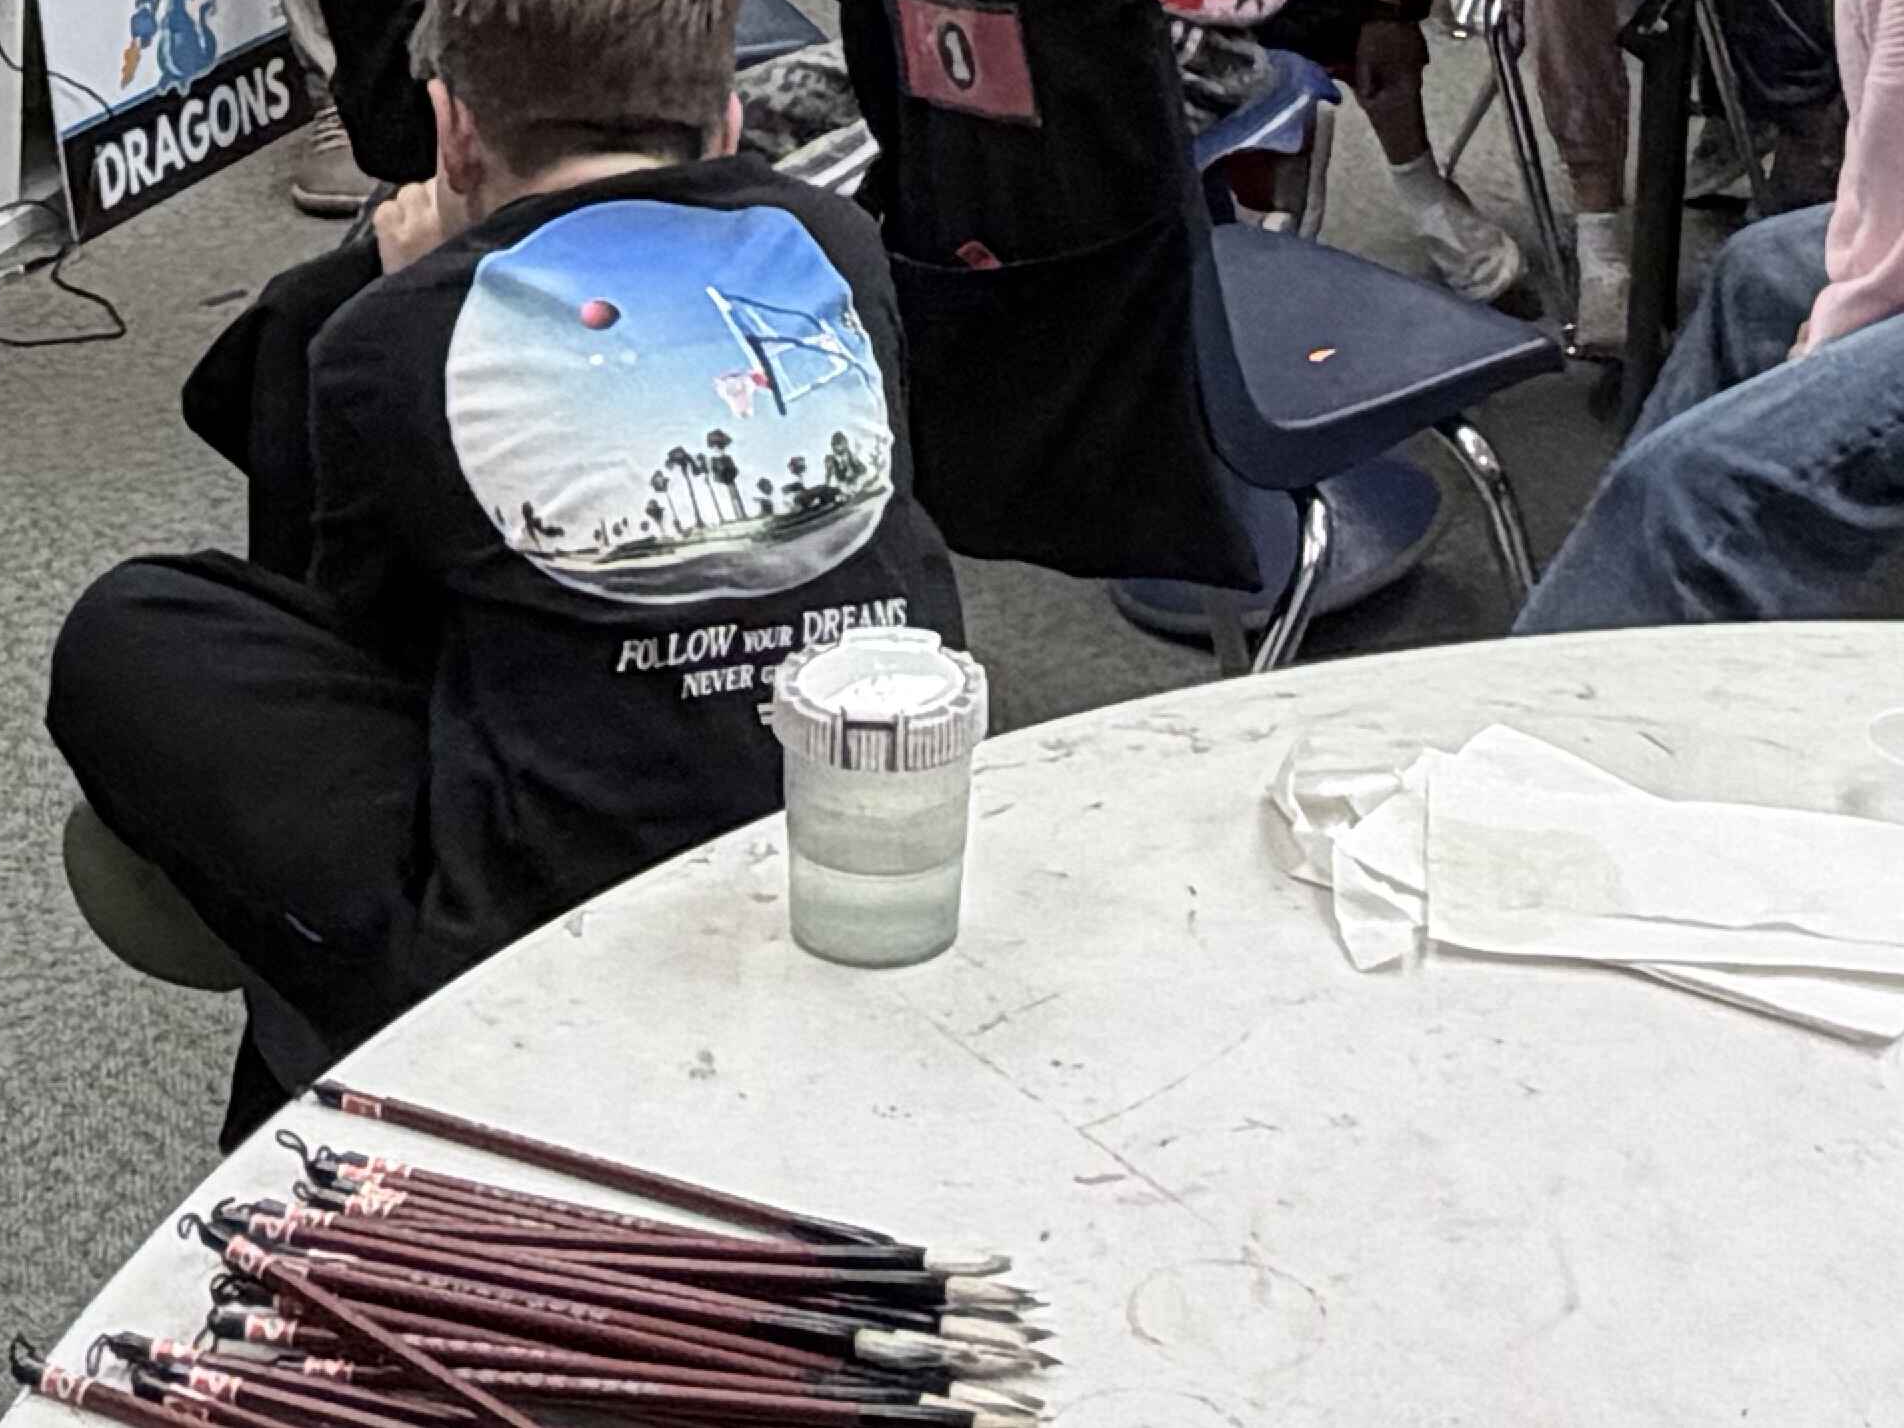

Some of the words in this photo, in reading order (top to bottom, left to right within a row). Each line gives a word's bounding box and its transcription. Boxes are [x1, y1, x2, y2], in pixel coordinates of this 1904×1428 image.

[96, 57, 290, 210] DRAGONS
[616, 623, 738, 673] FOLLOW
[742, 624, 794, 653] YOUR
[801, 597, 908, 645] DREAMS
[680, 664, 754, 700] NEVER
